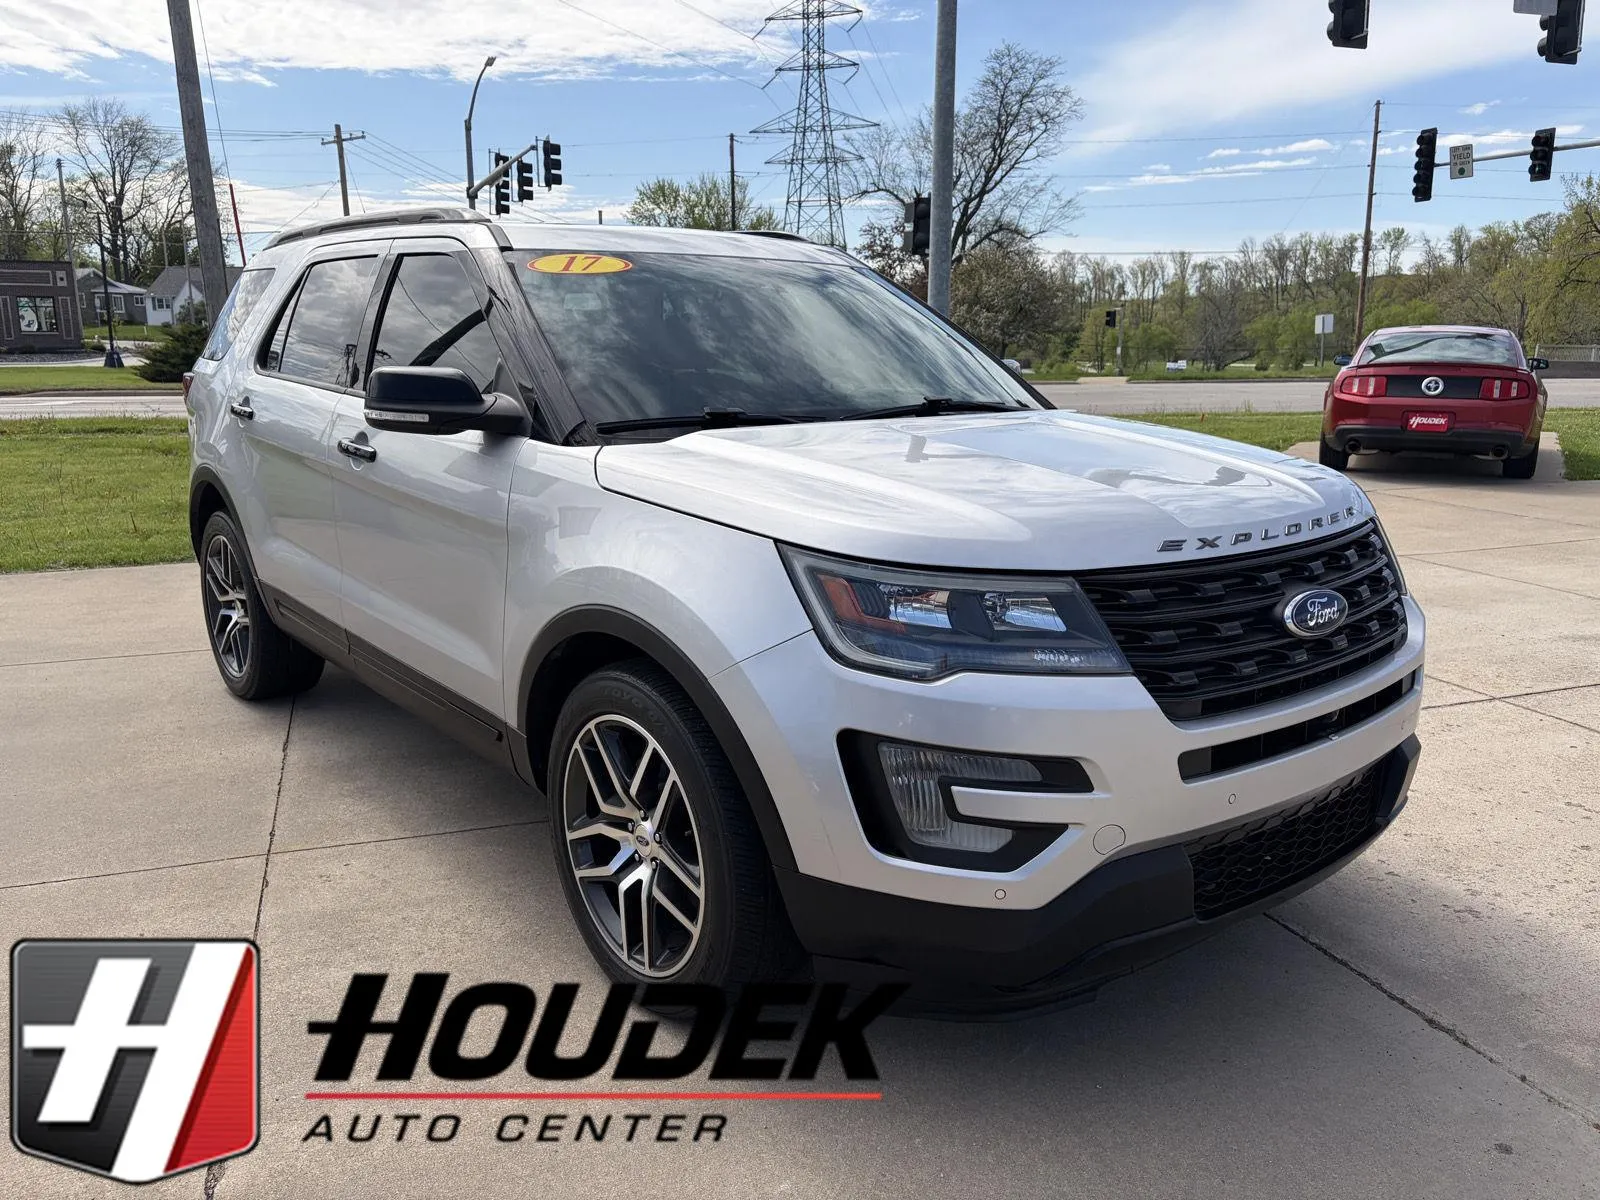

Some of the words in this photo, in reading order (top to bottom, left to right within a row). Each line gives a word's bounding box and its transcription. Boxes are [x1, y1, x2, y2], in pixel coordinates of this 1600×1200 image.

[1453, 152, 1471, 160] YIELD
[560, 255, 602, 272] 17
[1409, 416, 1447, 429] HOUDEK
[1156, 505, 1355, 552] EXPLORER
[1307, 596, 1340, 627] Ford
